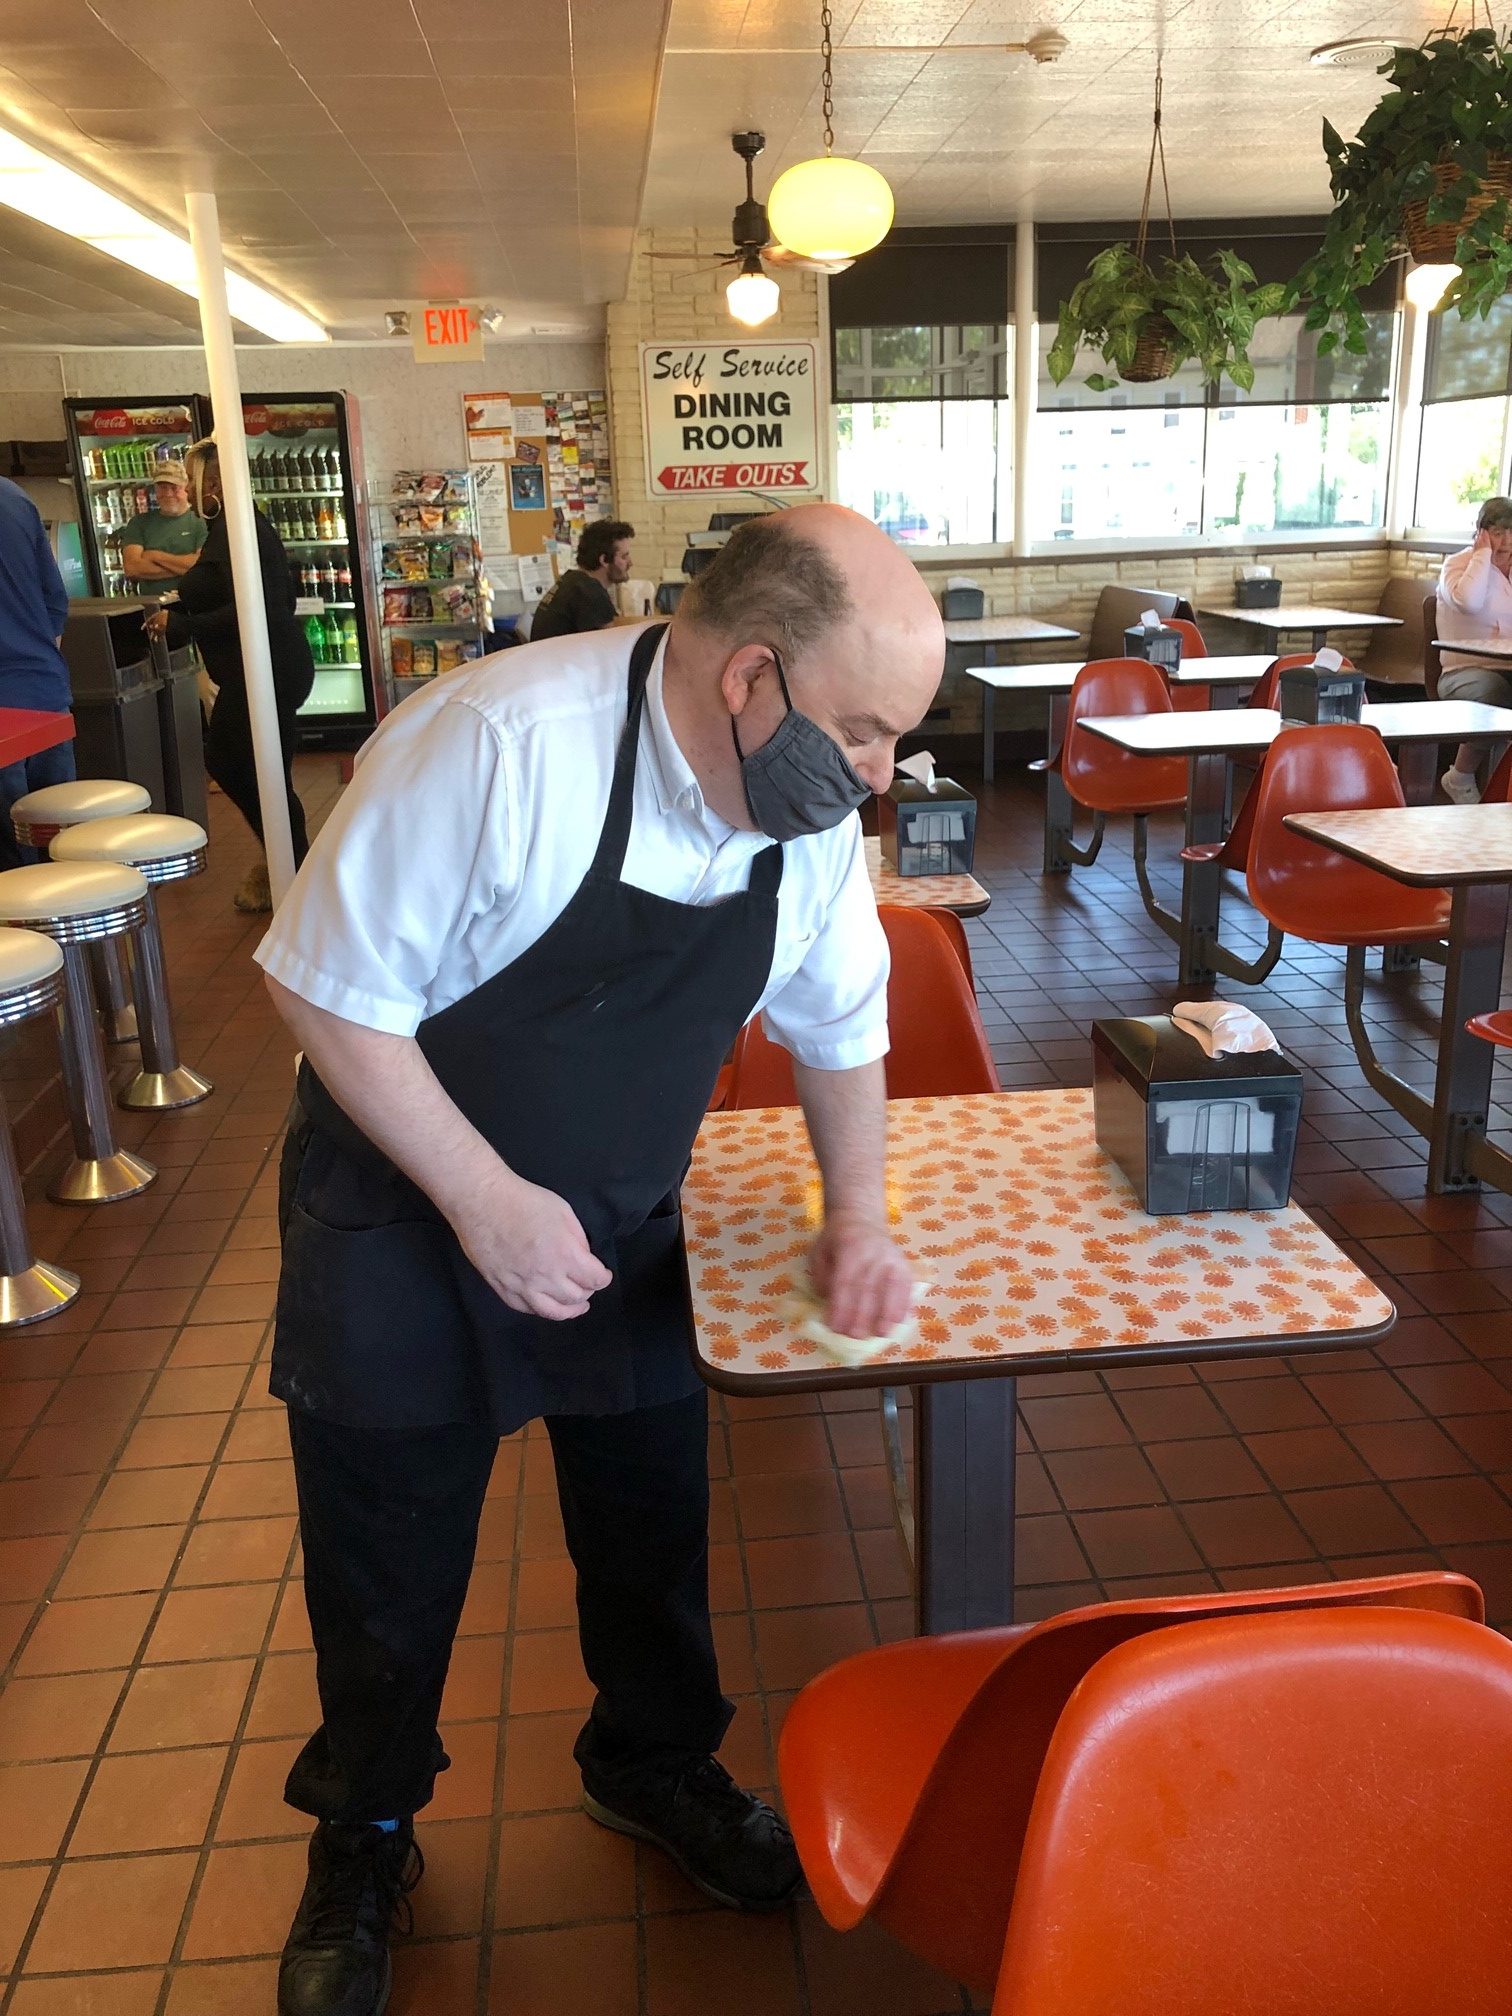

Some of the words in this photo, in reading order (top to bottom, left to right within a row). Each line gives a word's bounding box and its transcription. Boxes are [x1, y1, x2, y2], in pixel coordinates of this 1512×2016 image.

[424, 308, 469, 345] EXIT
[653, 350, 706, 388] Self
[720, 348, 809, 378] Service
[674, 391, 791, 419] DINING
[132, 417, 149, 426] ICE
[150, 416, 175, 426] COLD
[682, 423, 783, 451] ROOM
[672, 467, 726, 488] TAKE
[736, 463, 795, 487] OUTS
